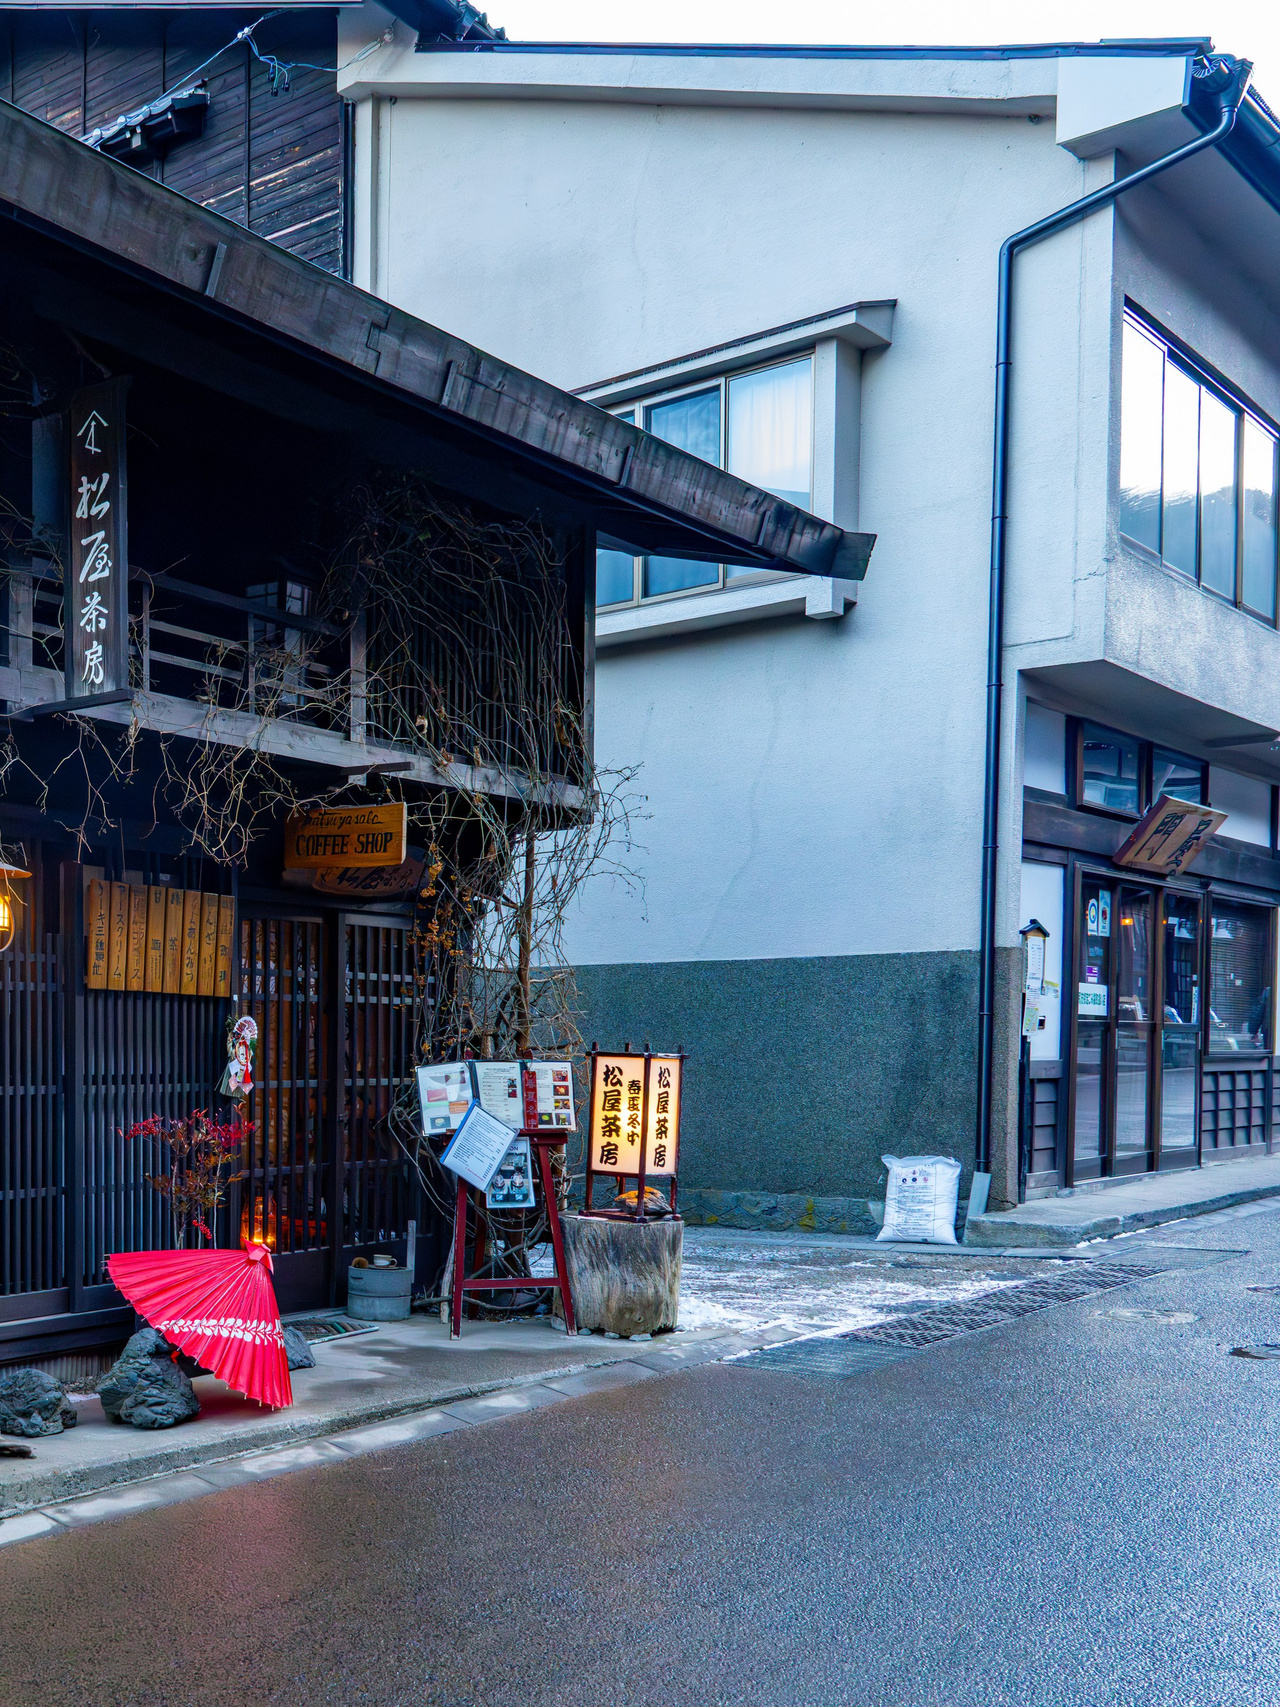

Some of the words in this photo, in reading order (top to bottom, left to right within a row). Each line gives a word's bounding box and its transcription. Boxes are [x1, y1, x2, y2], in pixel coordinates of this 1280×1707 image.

[75, 472, 112, 684] 松屋茶房
[296, 834, 349, 856] COFFEE
[355, 832, 393, 854] SHOP
[599, 1064, 623, 1165] 松屋茶房
[626, 1079, 641, 1146] 春夏冬中
[653, 1066, 671, 1167] 松屋茶房
